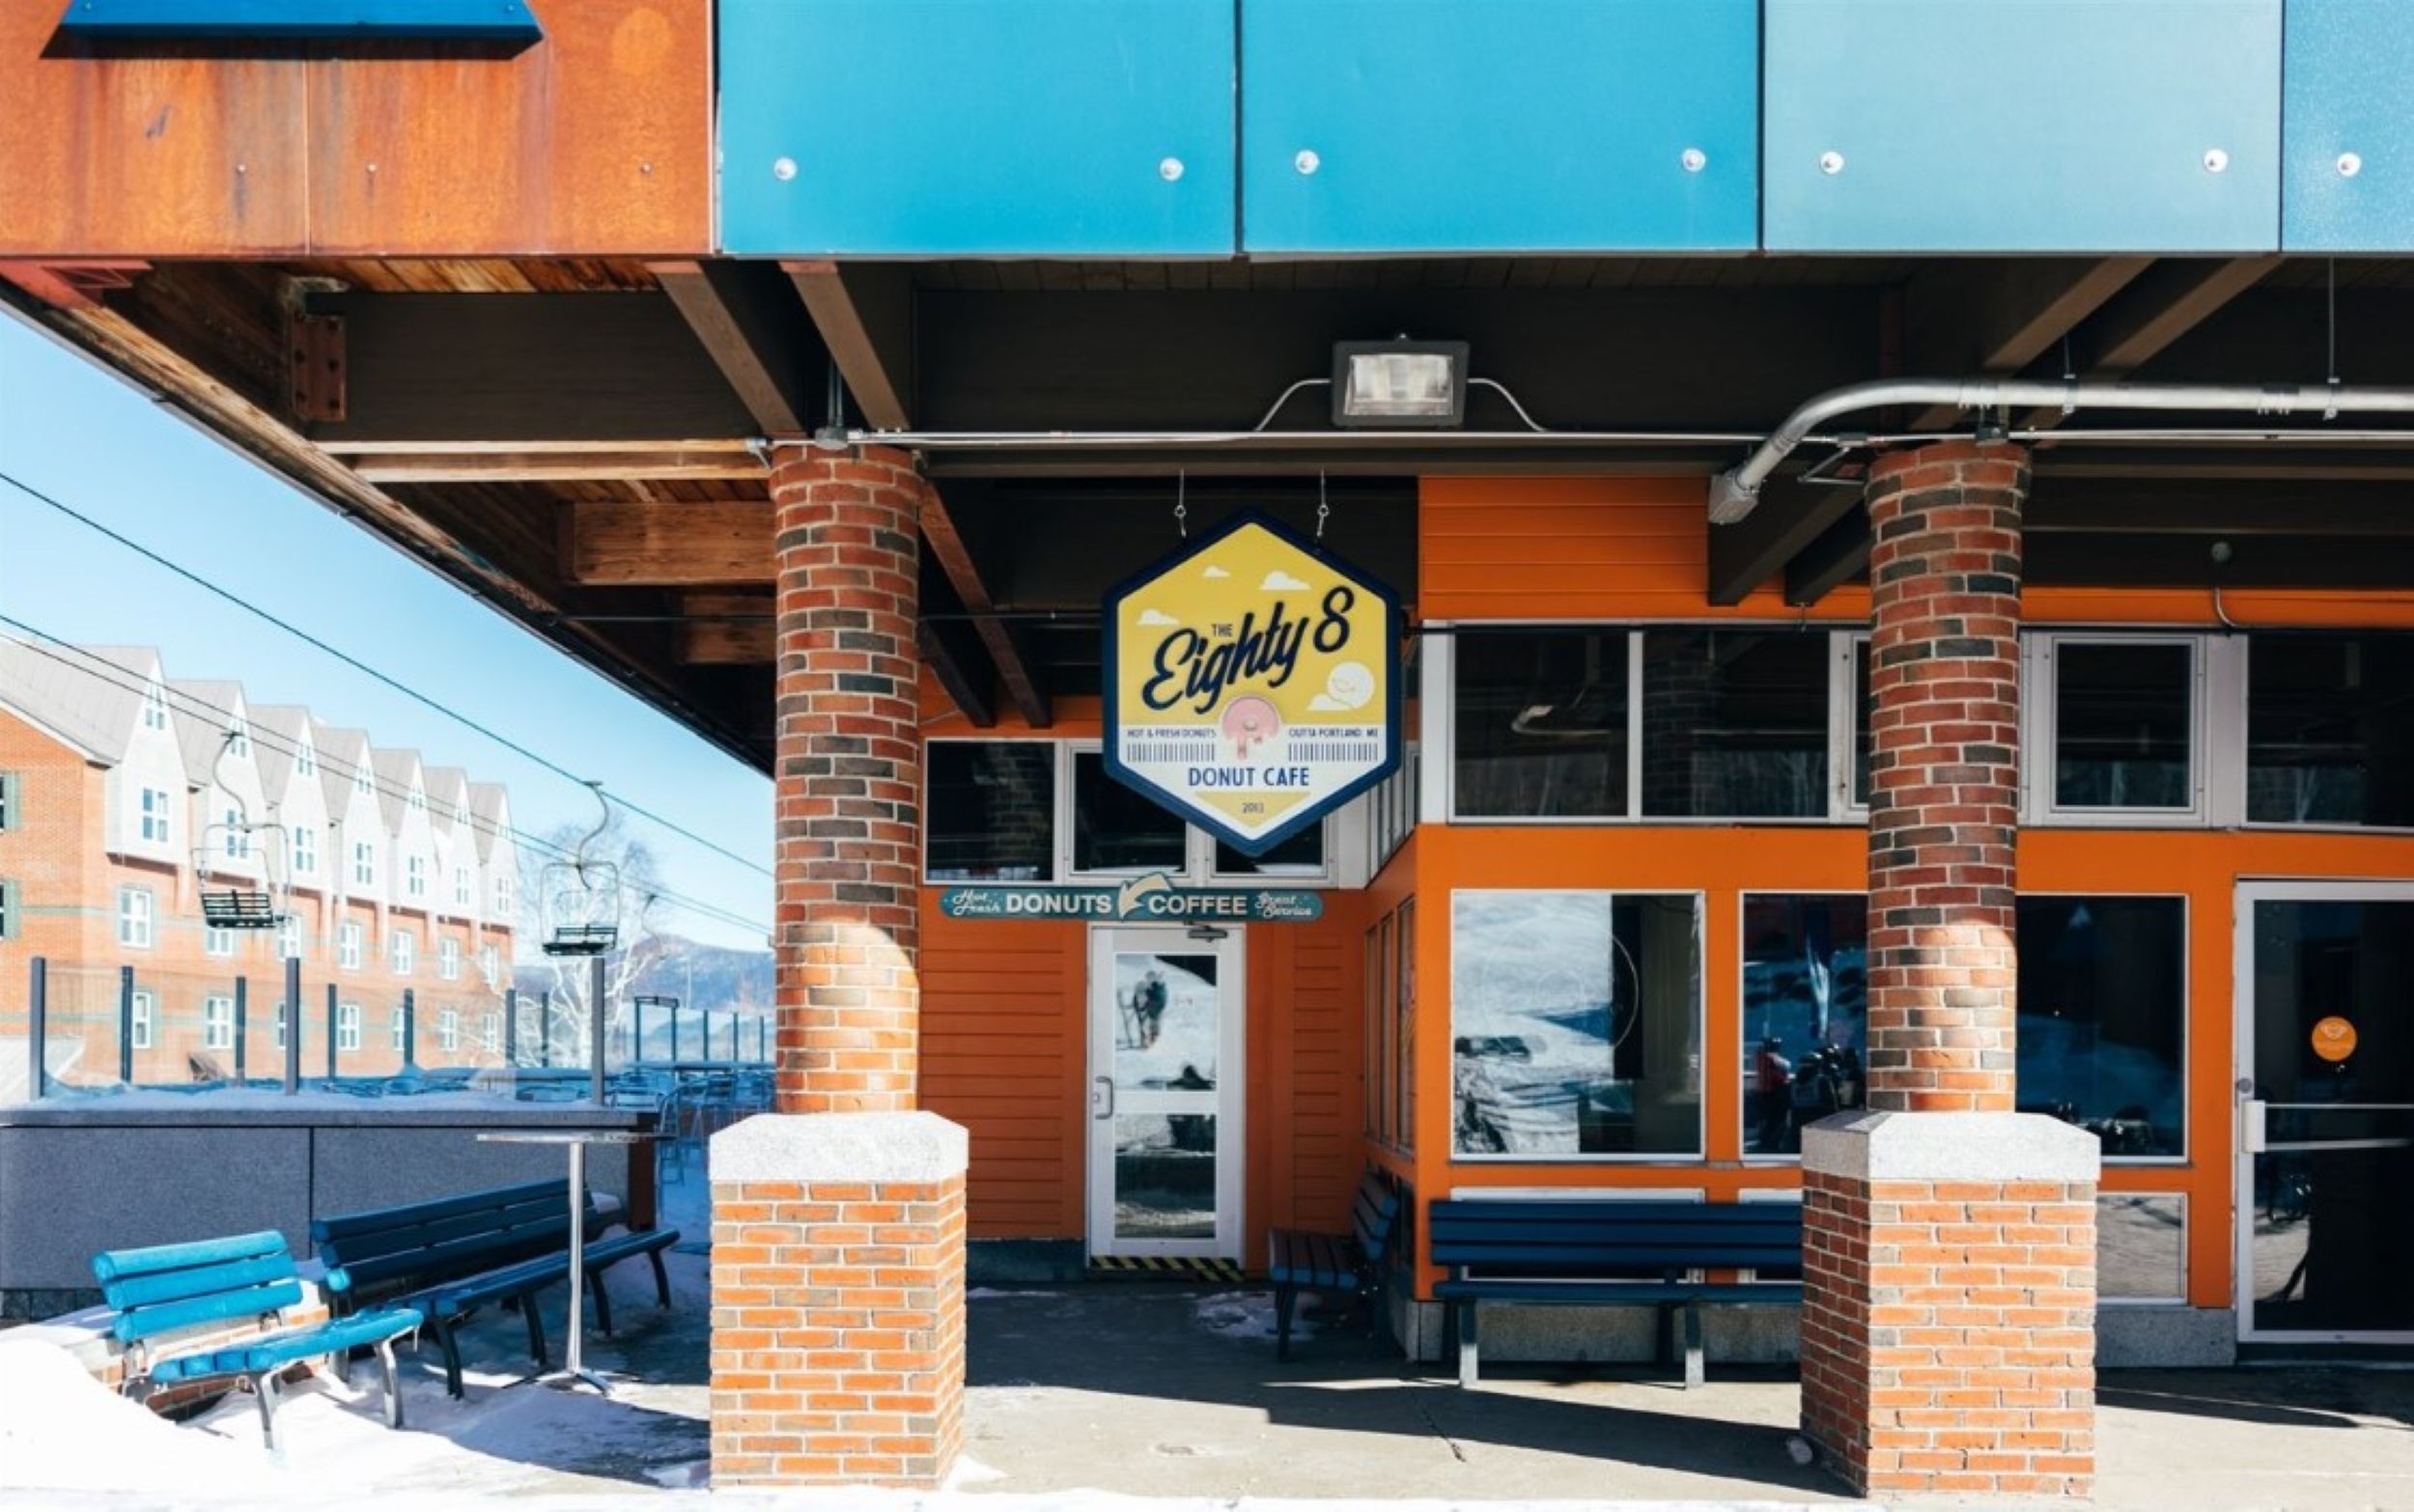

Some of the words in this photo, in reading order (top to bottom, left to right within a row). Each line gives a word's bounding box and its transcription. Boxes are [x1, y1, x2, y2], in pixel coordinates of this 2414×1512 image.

[1211, 624, 1233, 638] THE
[1141, 600, 1310, 715] Eighty
[1312, 585, 1356, 654] 8
[1181, 728, 1217, 739] DONUTS
[1189, 768, 1255, 787] DONUT
[1263, 768, 1310, 787] CAFE
[1005, 894, 1113, 914] DONUTS
[1147, 895, 1249, 914] COFFEE
